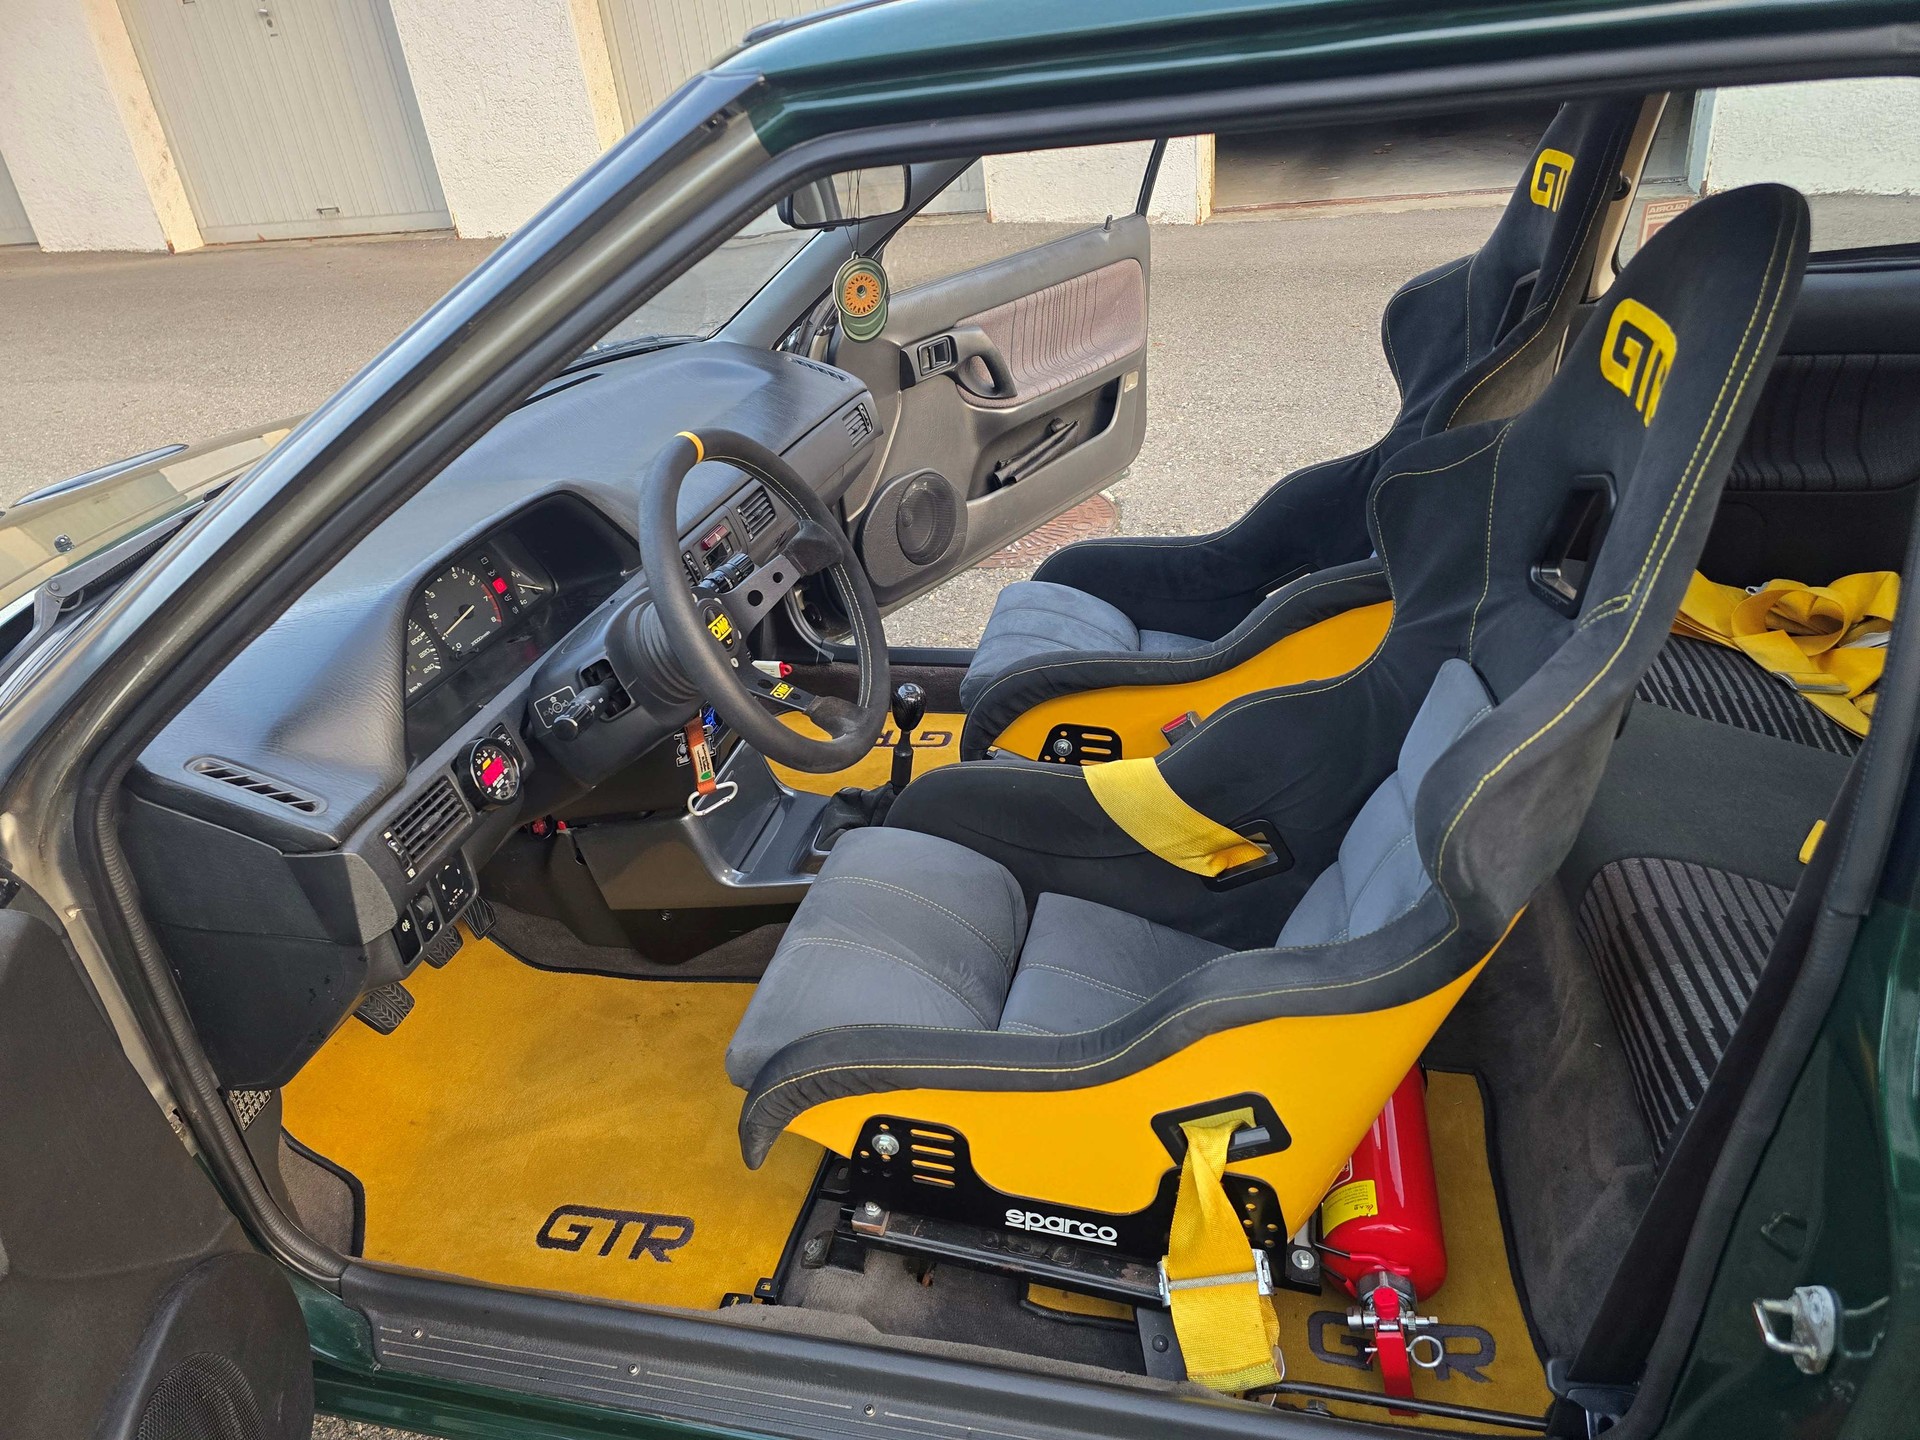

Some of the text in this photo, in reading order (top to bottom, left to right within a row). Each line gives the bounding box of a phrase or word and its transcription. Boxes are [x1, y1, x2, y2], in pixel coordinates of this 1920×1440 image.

[452, 572, 459, 580] 5
[429, 591, 436, 599] 3
[711, 616, 732, 639] OMP
[410, 635, 423, 646] 200
[418, 648, 431, 659] 220
[422, 663, 435, 674] 240
[408, 682, 423, 694] km/h
[773, 683, 790, 699] OMP
[1004, 1208, 1119, 1242] sparco
[535, 1203, 696, 1264] GTR
[1307, 1309, 1497, 1384] GR
